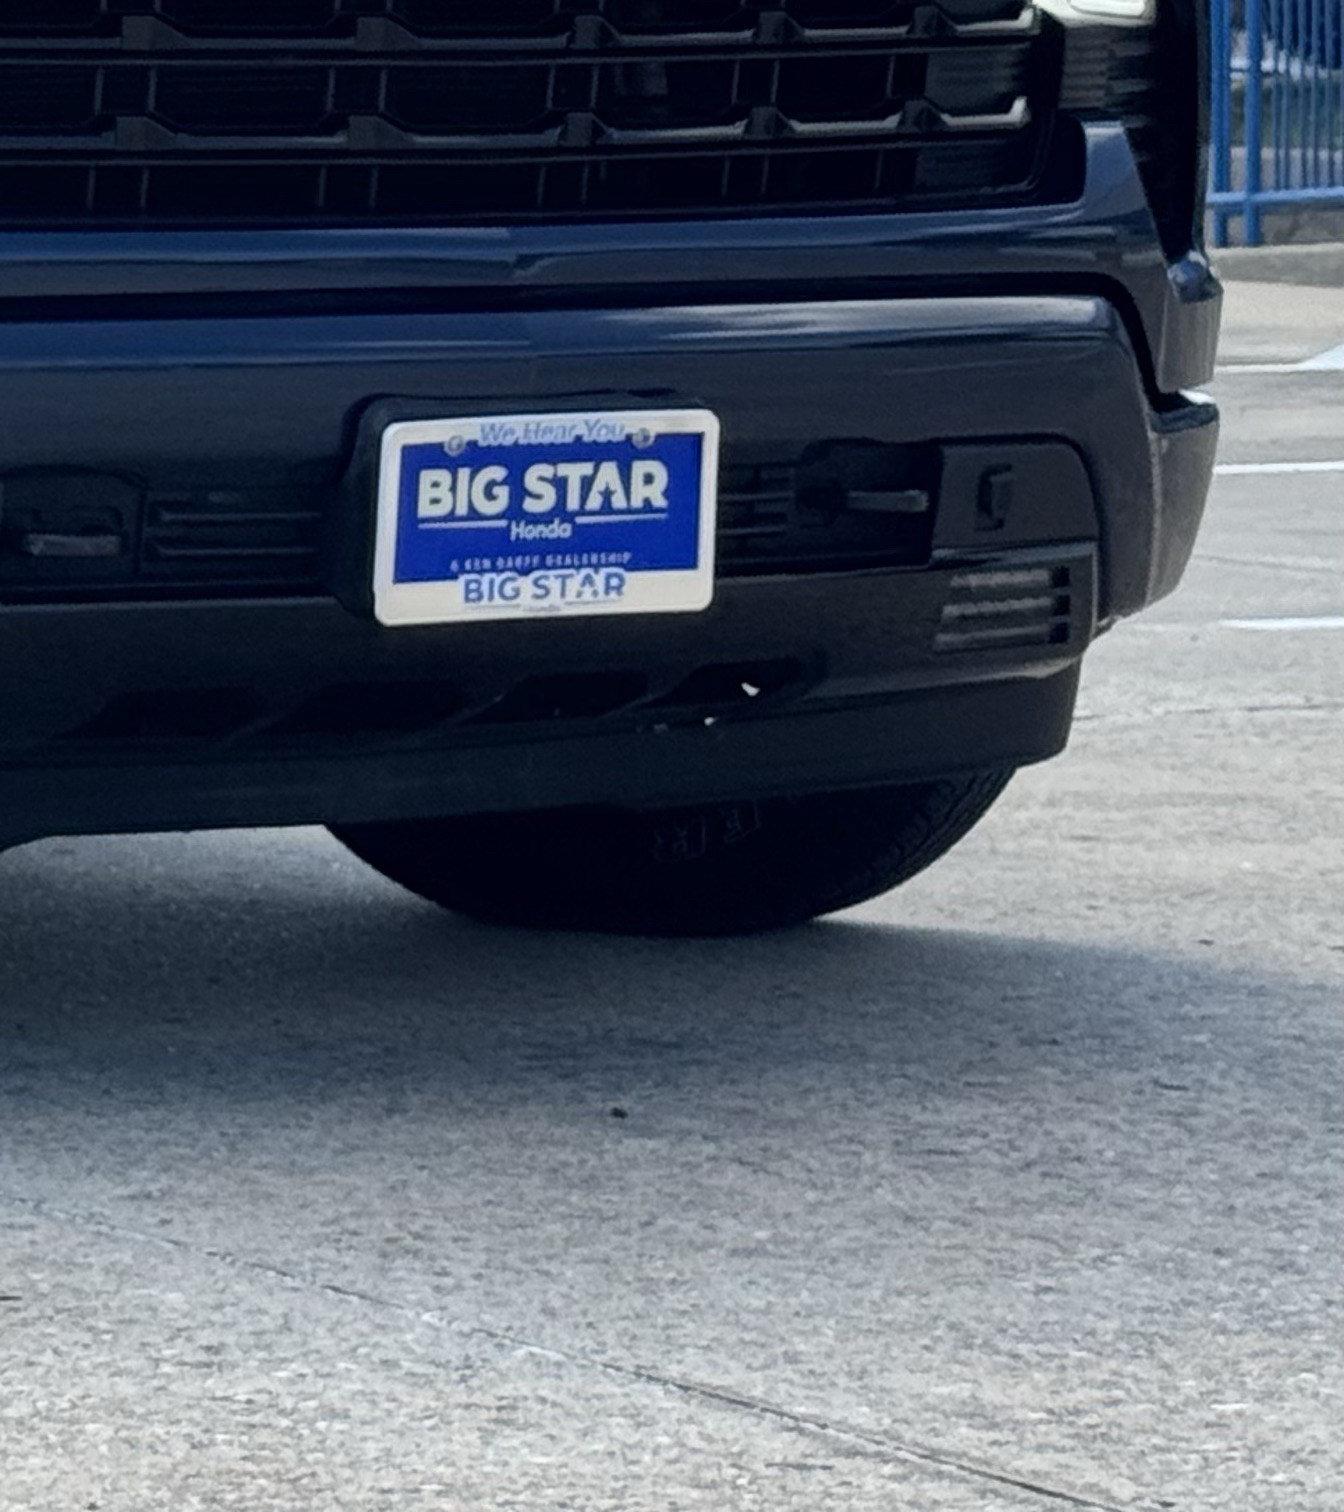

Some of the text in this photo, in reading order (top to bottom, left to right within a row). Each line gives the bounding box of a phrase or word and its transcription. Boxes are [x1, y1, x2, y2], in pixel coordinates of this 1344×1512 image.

[480, 419, 627, 443] We Hear You
[418, 461, 668, 519] BIG STAR
[511, 518, 572, 542] Honda
[464, 572, 626, 603] BIG STAR
